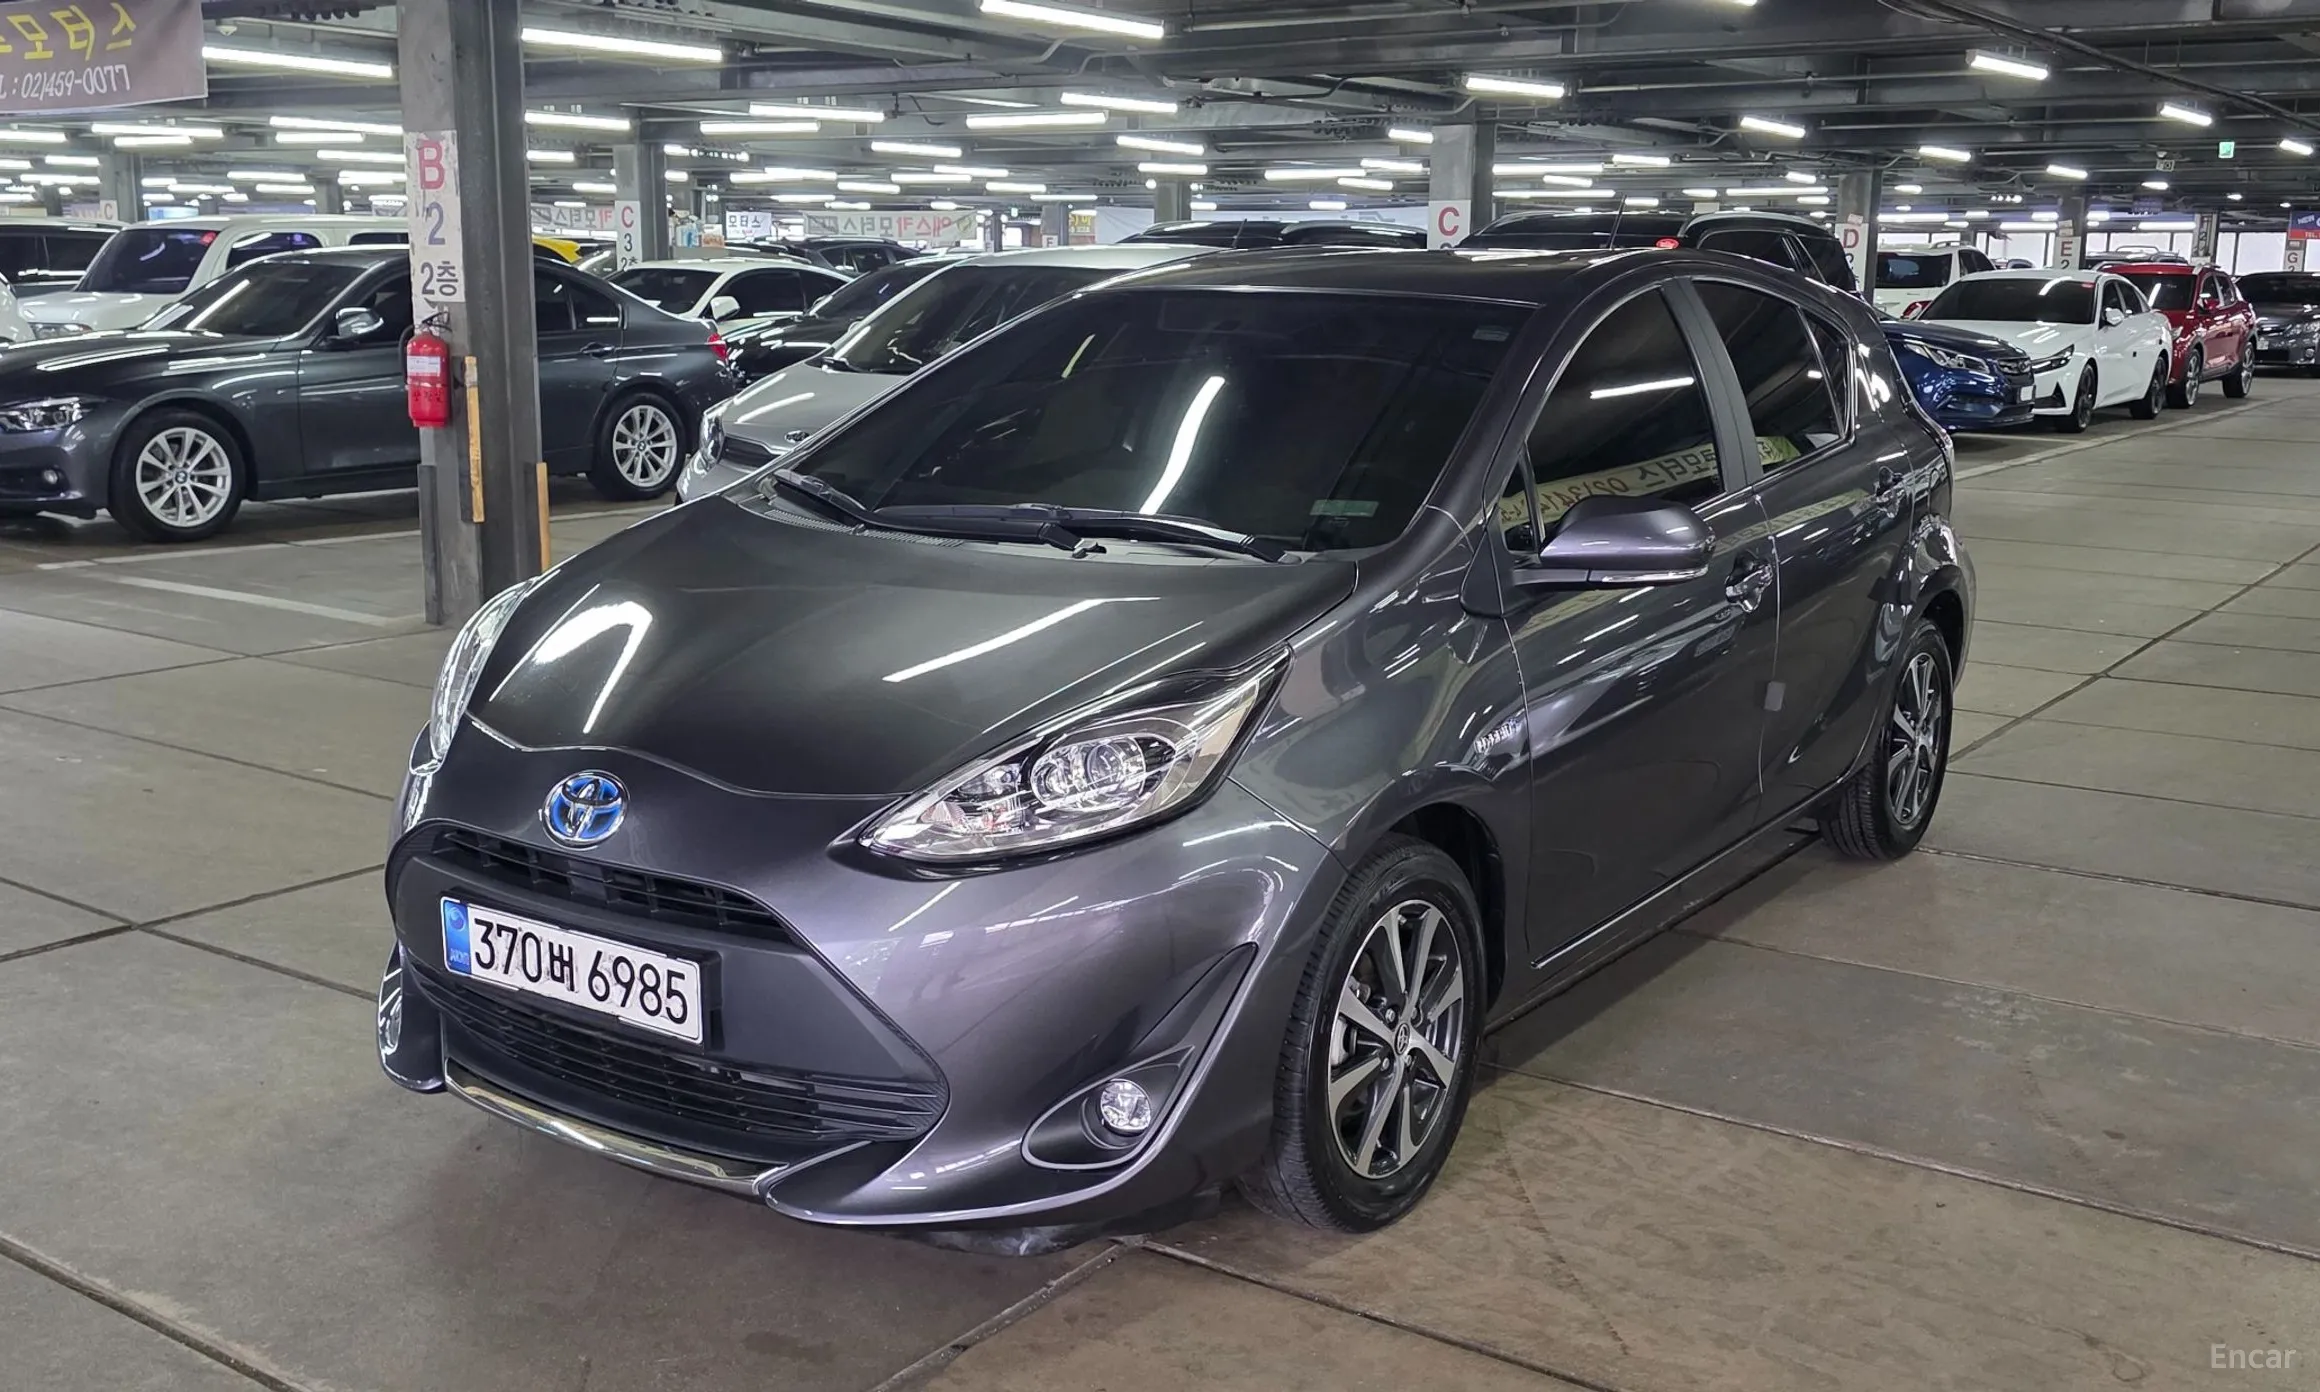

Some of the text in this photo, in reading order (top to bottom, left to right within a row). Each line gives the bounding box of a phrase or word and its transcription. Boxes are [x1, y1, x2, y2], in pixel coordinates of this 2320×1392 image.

[21, 64, 131, 101] 02)459-0077
[418, 140, 445, 189] B
[428, 201, 446, 246] 2
[621, 206, 634, 228] C
[1438, 207, 1459, 237] C
[624, 233, 633, 252] 3
[1843, 228, 1859, 249] D
[2061, 241, 2073, 257] E
[2287, 252, 2298, 264] G
[420, 260, 458, 297] 2층
[474, 917, 689, 1025] 370버 6985
